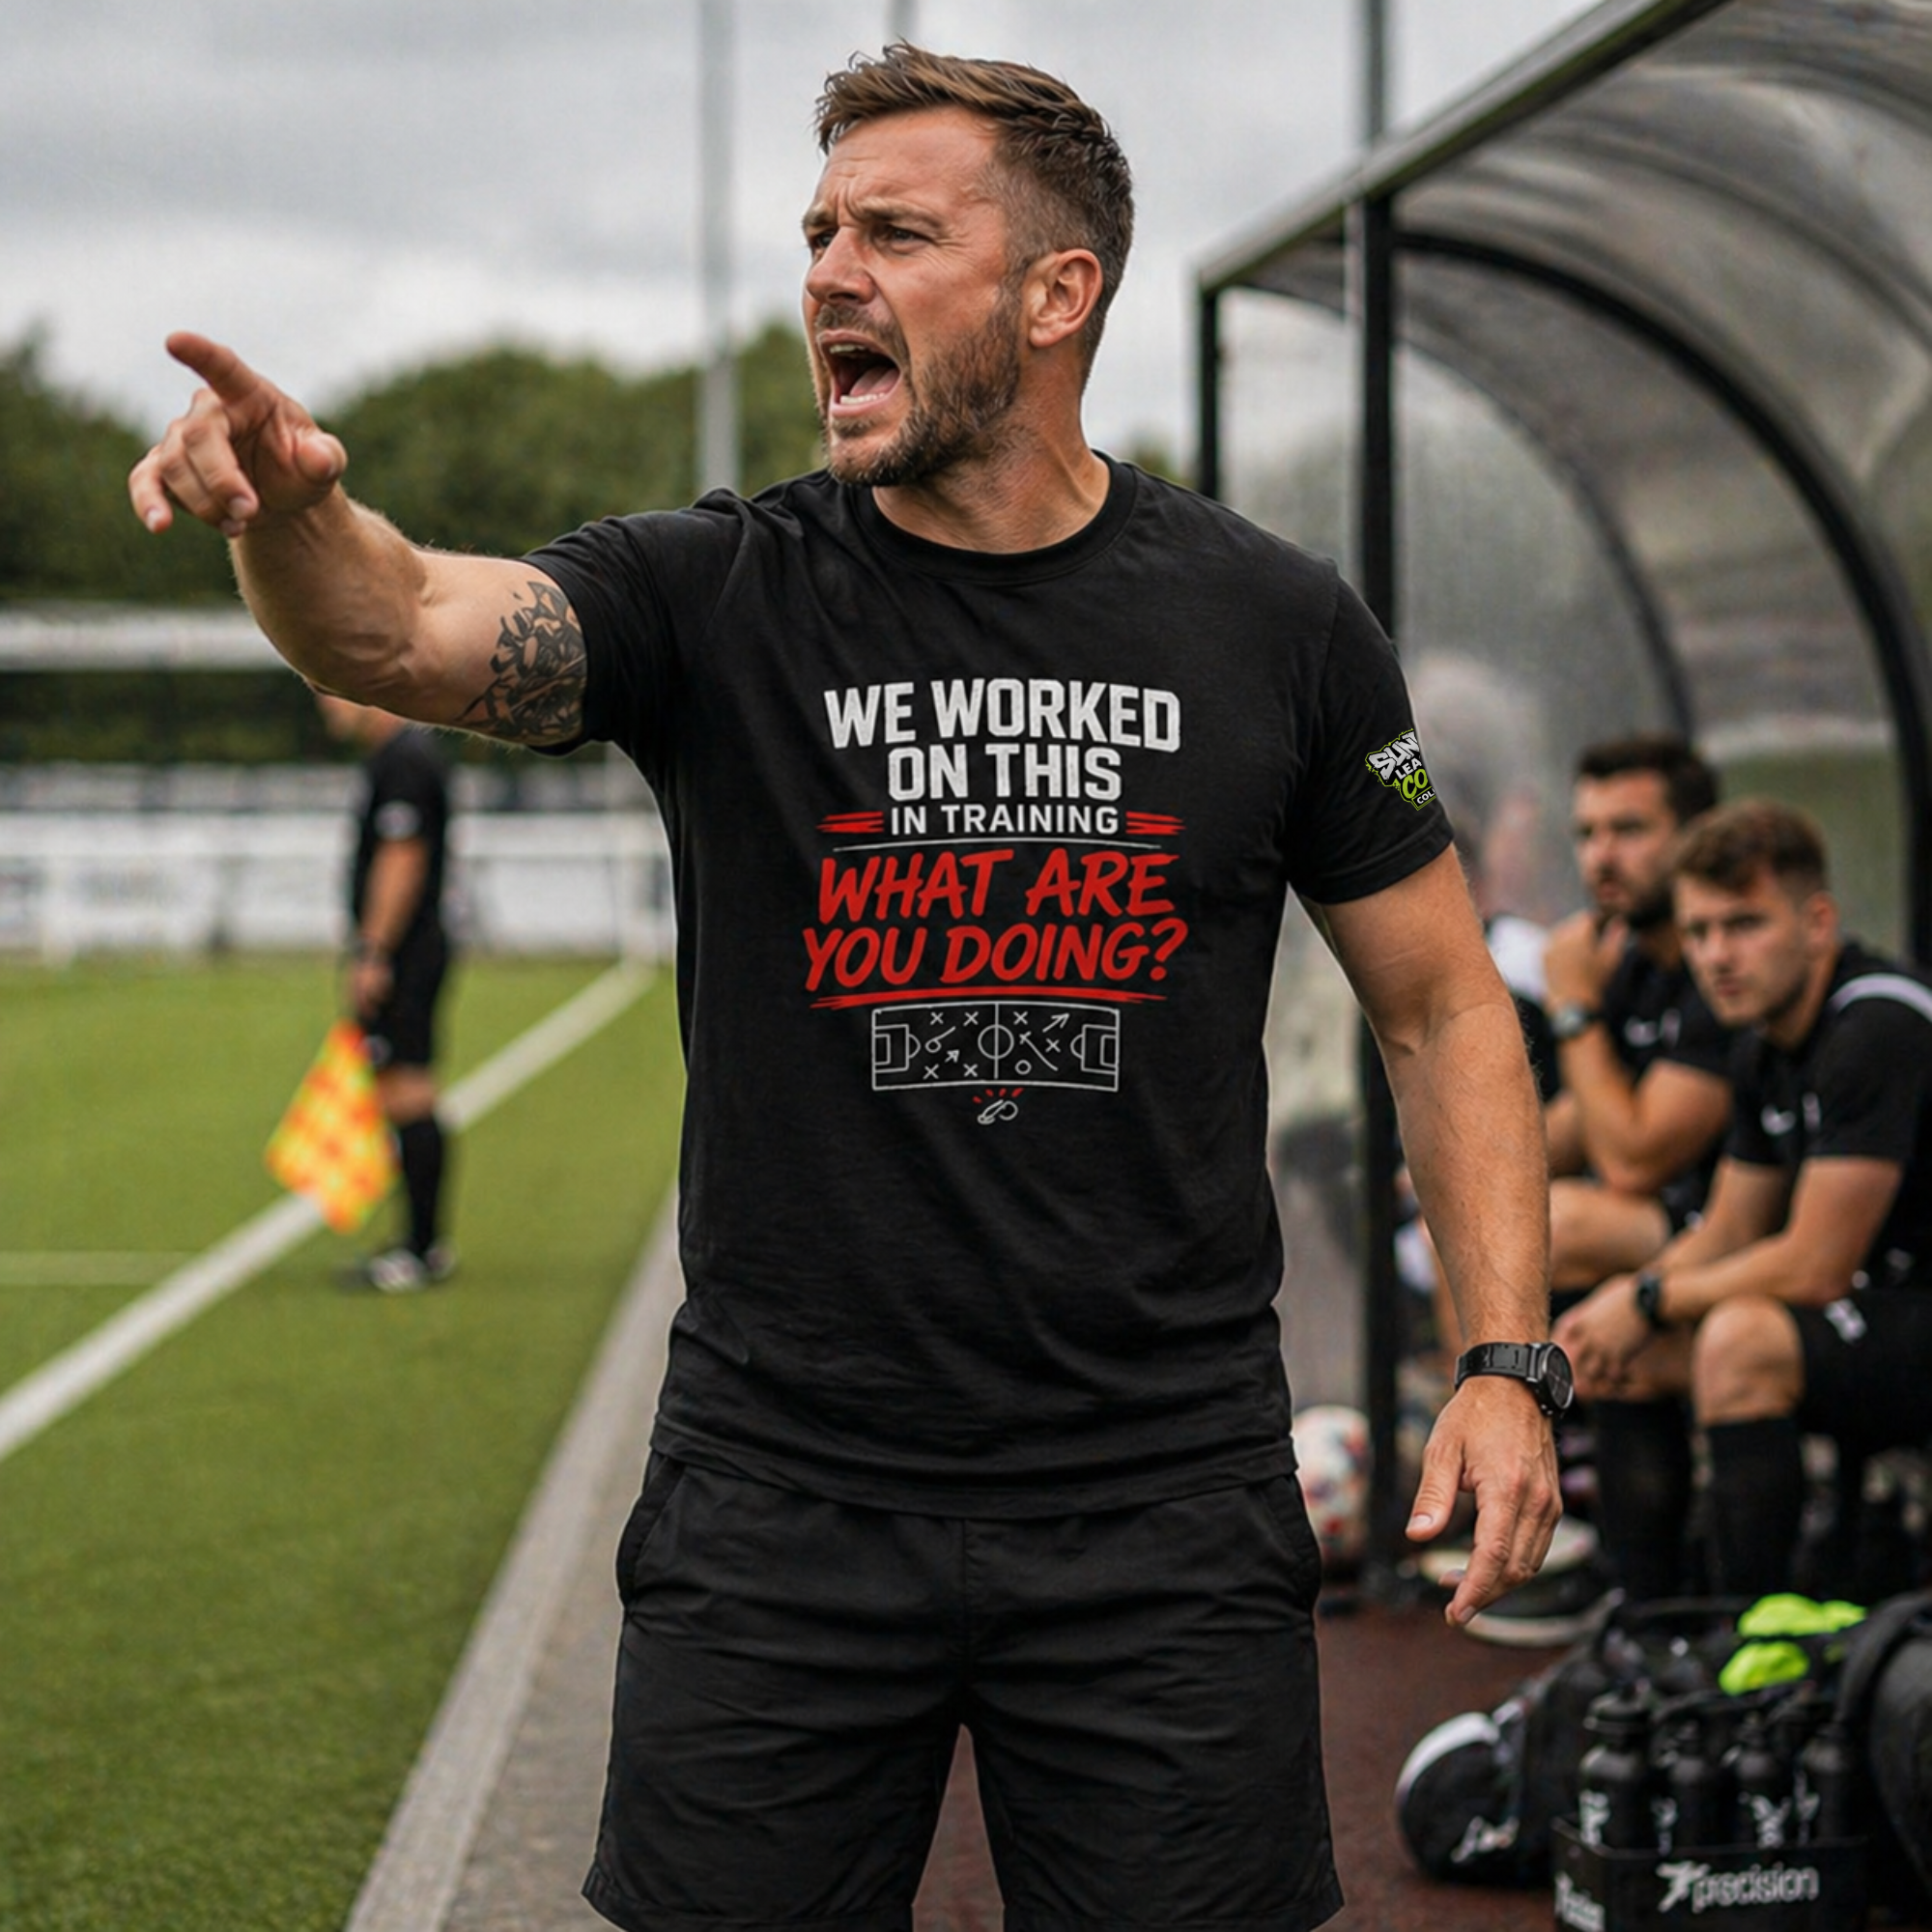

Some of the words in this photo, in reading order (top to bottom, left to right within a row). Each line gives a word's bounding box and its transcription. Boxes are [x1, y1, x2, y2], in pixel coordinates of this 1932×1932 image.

[824, 682, 917, 749] WE
[930, 678, 1180, 753] WORKED
[889, 744, 968, 801] ON
[984, 744, 1122, 801] THIS
[1395, 757, 1423, 781] LEA
[1416, 788, 1435, 805] COL
[891, 806, 926, 835] IN
[940, 804, 1119, 835] TRAINING
[818, 848, 1014, 923] WHAT
[1025, 848, 1179, 918] ARE
[803, 927, 928, 992] YOU
[939, 918, 1189, 983] DOING?
[1692, 1861, 1819, 1914] precision
